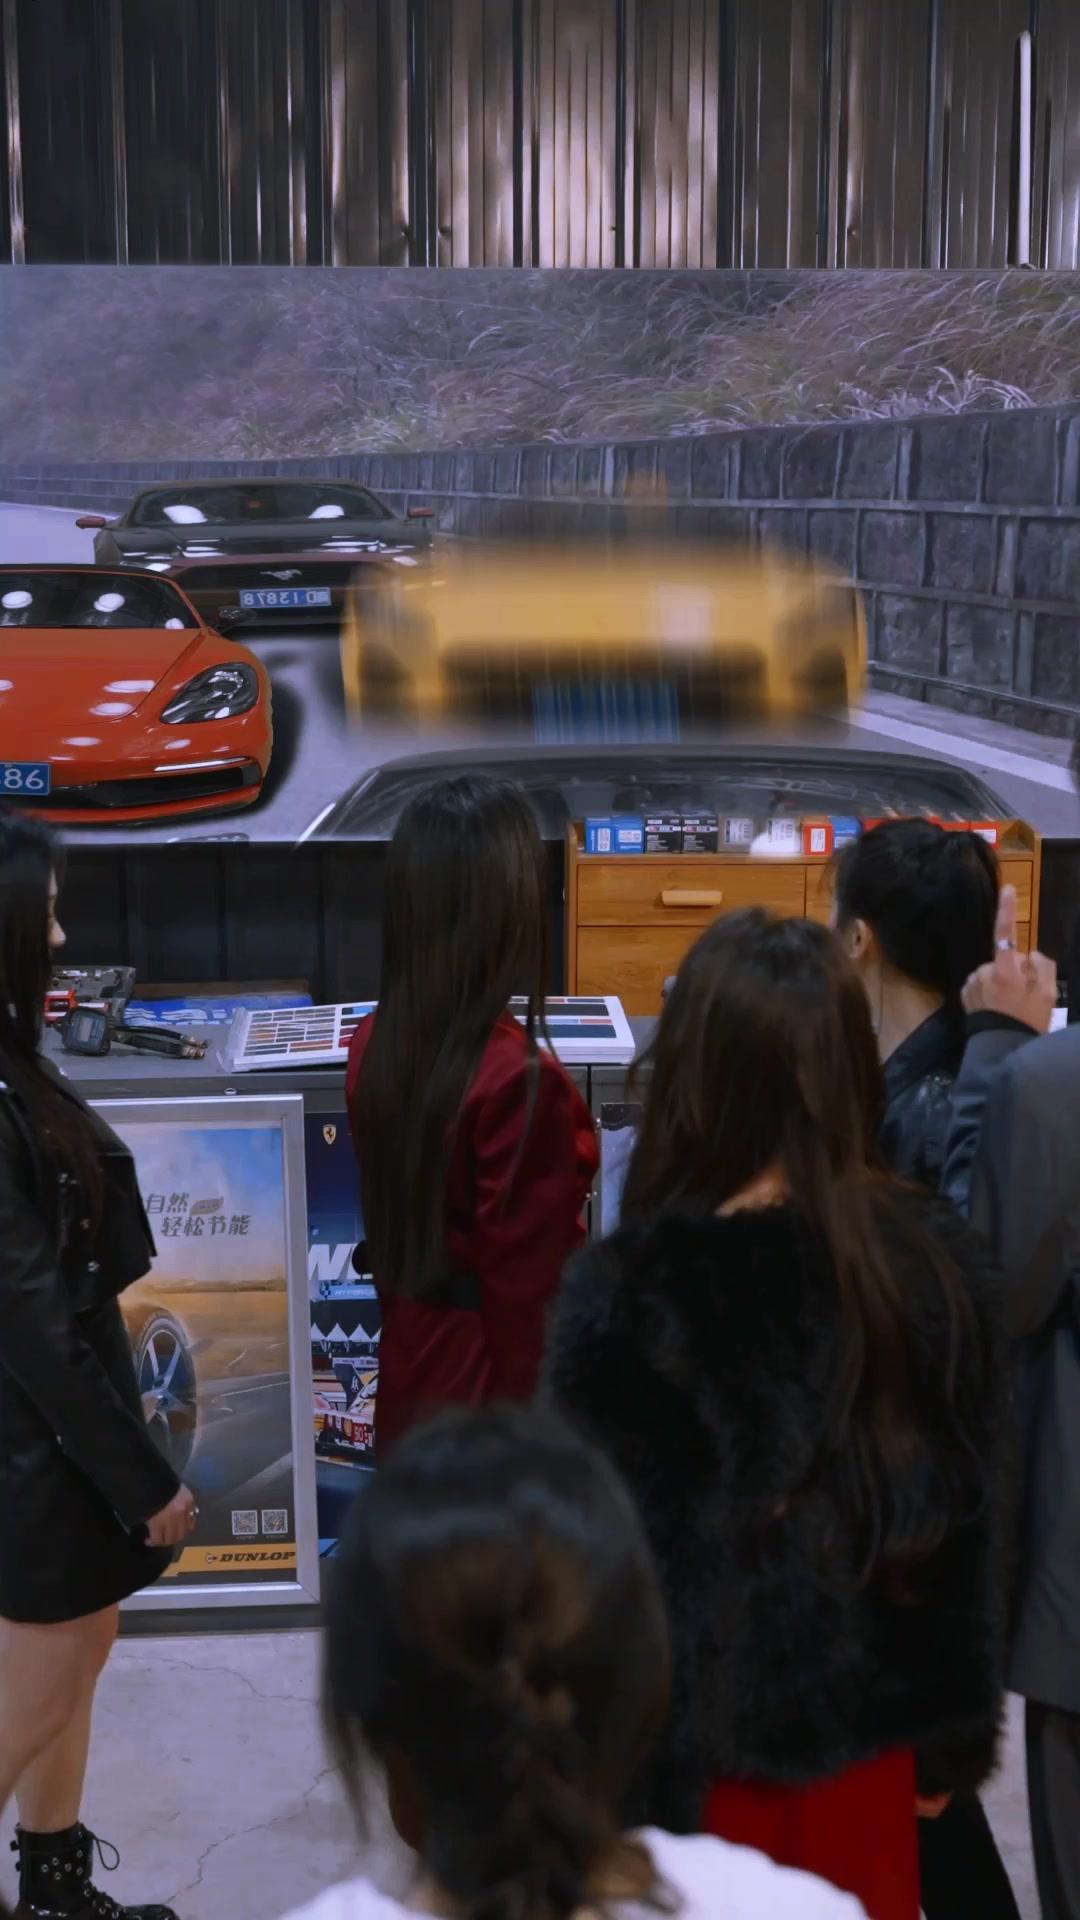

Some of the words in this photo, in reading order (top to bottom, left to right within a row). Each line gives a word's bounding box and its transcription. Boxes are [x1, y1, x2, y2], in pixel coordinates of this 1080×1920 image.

[160, 1215, 251, 1238] 轻松节能
[219, 1551, 297, 1563] DUNLOP
